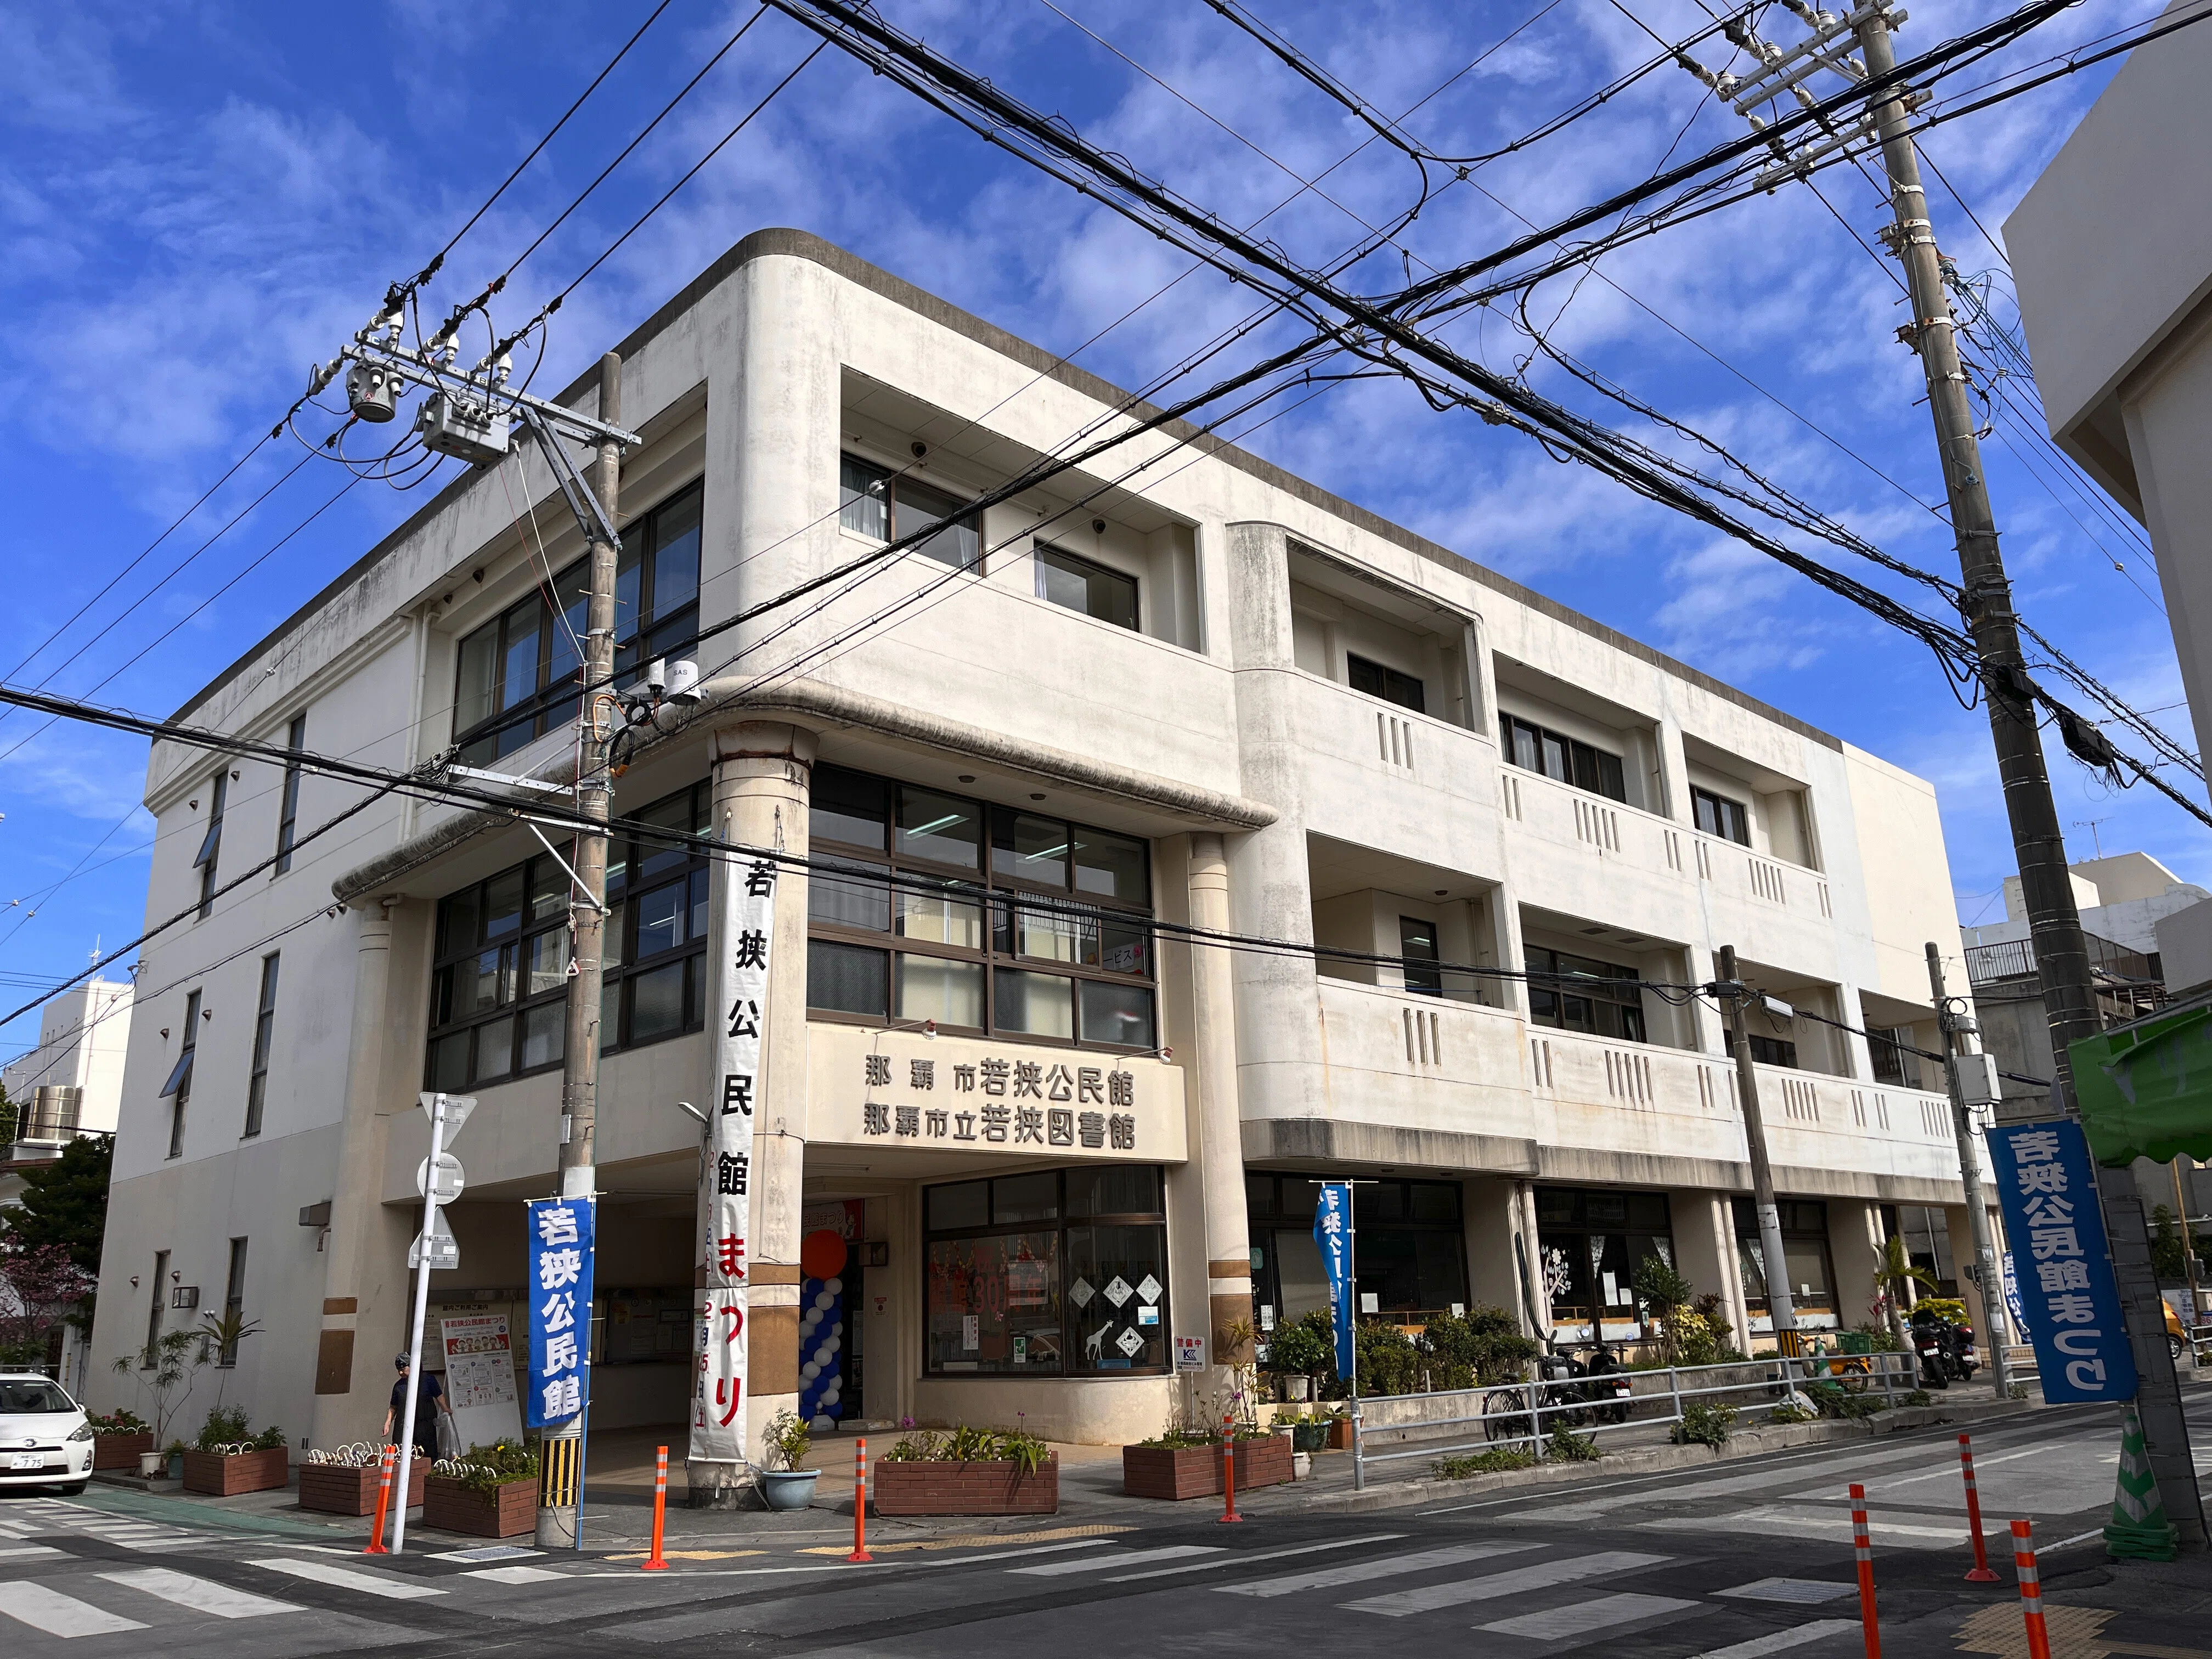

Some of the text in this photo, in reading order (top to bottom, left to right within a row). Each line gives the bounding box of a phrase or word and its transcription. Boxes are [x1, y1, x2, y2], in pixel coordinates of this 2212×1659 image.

[715, 859, 777, 1428] 若狭公民館まつり
[864, 1102, 1136, 1150] 那覇市立若狭図書館
[450, 1316, 505, 1327] 若狭公民館まつり
[538, 1207, 583, 1420] 若狭公民館
[1176, 1338, 1202, 1348] 警備中
